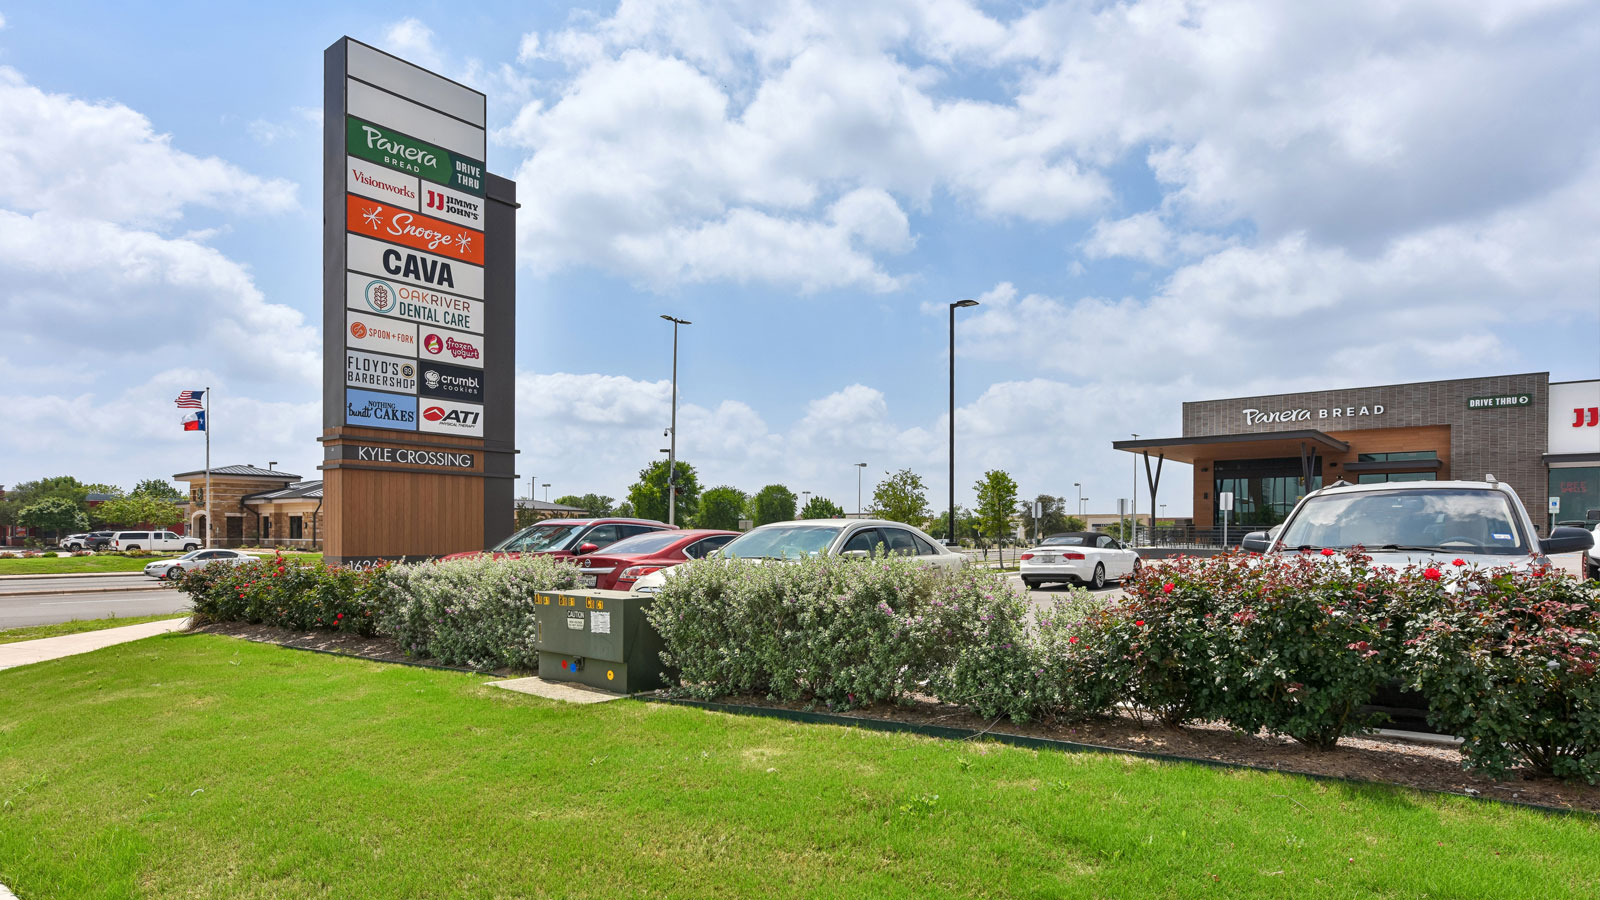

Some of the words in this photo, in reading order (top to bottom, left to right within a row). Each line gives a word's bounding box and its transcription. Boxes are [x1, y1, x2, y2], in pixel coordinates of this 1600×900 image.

[362, 125, 437, 169] Panera
[384, 156, 420, 173] BREAD
[456, 160, 481, 178] DRIVE
[352, 168, 415, 199] Visionworks
[457, 173, 480, 190] THRU
[426, 189, 445, 211] JJ
[446, 195, 479, 211] JIMMY
[446, 204, 479, 220] JOHN'S
[386, 212, 452, 250] Snooze
[382, 248, 455, 288] CAVA
[398, 287, 470, 312] OAKRIVER
[399, 301, 440, 323] DENTAL
[444, 311, 470, 329] CARE
[368, 327, 391, 341] SPOON
[397, 332, 414, 344] FORK
[447, 337, 473, 350] frozen
[452, 346, 478, 359] yogurt
[348, 356, 399, 376] FLOYD'S
[348, 370, 415, 390] BARBERSHOP
[441, 374, 479, 388] crumbl
[443, 384, 478, 394] cookies
[368, 400, 395, 409] NOTHING
[1469, 397, 1493, 407] DRIVE
[1495, 396, 1517, 406] THRU
[347, 402, 373, 418] bundt
[374, 407, 414, 423] CAKES
[442, 409, 480, 425] ATI
[1242, 407, 1311, 426] Panera
[1319, 404, 1386, 419] BREAD
[1572, 407, 1599, 427] JJ
[358, 446, 392, 462] KYLE
[396, 449, 471, 468] CROSSING
